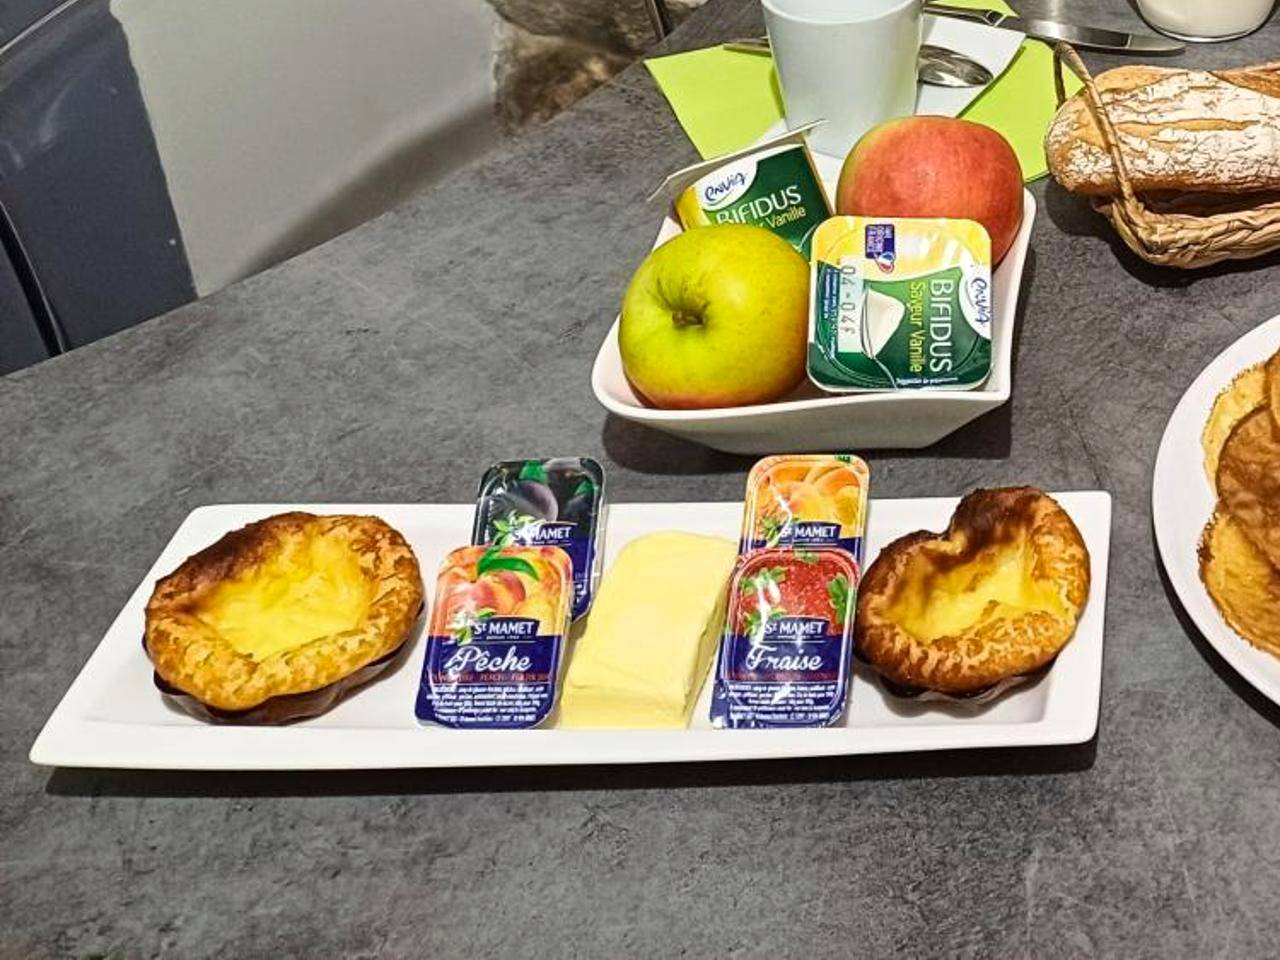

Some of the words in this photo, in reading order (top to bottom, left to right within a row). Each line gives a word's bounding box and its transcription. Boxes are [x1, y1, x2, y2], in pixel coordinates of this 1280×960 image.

[767, 205, 807, 228] Vanille
[907, 281, 926, 328] Saveur
[930, 278, 954, 373] BIFIDUS
[908, 330, 926, 373] Vanille
[794, 525, 837, 538] MAMET
[488, 621, 535, 635] MAMET
[779, 621, 825, 634] MAMET
[443, 644, 534, 672] Pêche
[745, 643, 824, 672] Fraise
